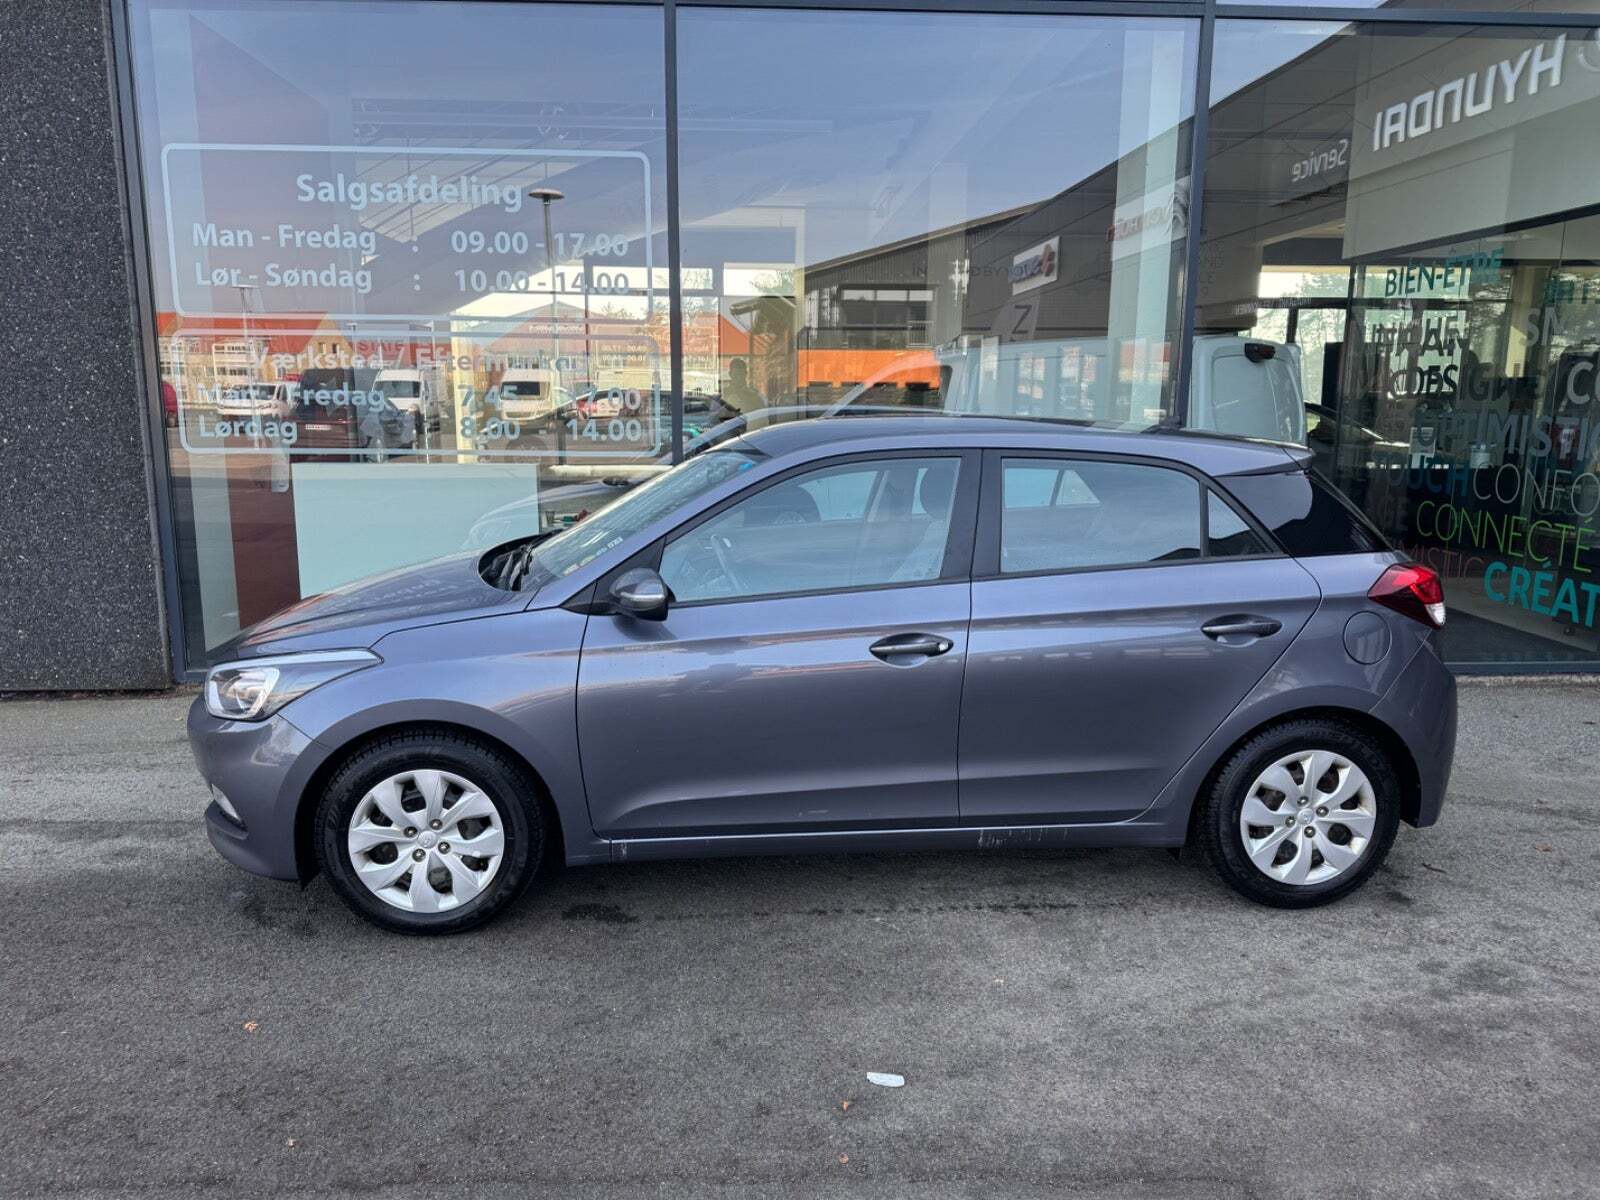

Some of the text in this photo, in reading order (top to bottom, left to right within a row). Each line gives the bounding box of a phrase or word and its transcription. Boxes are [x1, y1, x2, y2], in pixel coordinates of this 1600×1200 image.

[296, 172, 523, 213] Salgsafdeling
[191, 223, 254, 248] Man
[278, 224, 377, 255] Fredag
[450, 230, 529, 254] 09.00
[553, 232, 630, 257] 17.00
[194, 262, 242, 287] Lør
[264, 262, 374, 295] Søndag
[454, 269, 530, 293] 10.00
[555, 271, 630, 294] 14.00
[286, 382, 387, 412] Fredag
[200, 415, 298, 444] Lørdag
[566, 418, 643, 443] 14.00
[1416, 500, 1596, 573] CONNECTÉ
[1484, 560, 1600, 628] CRÉAT
